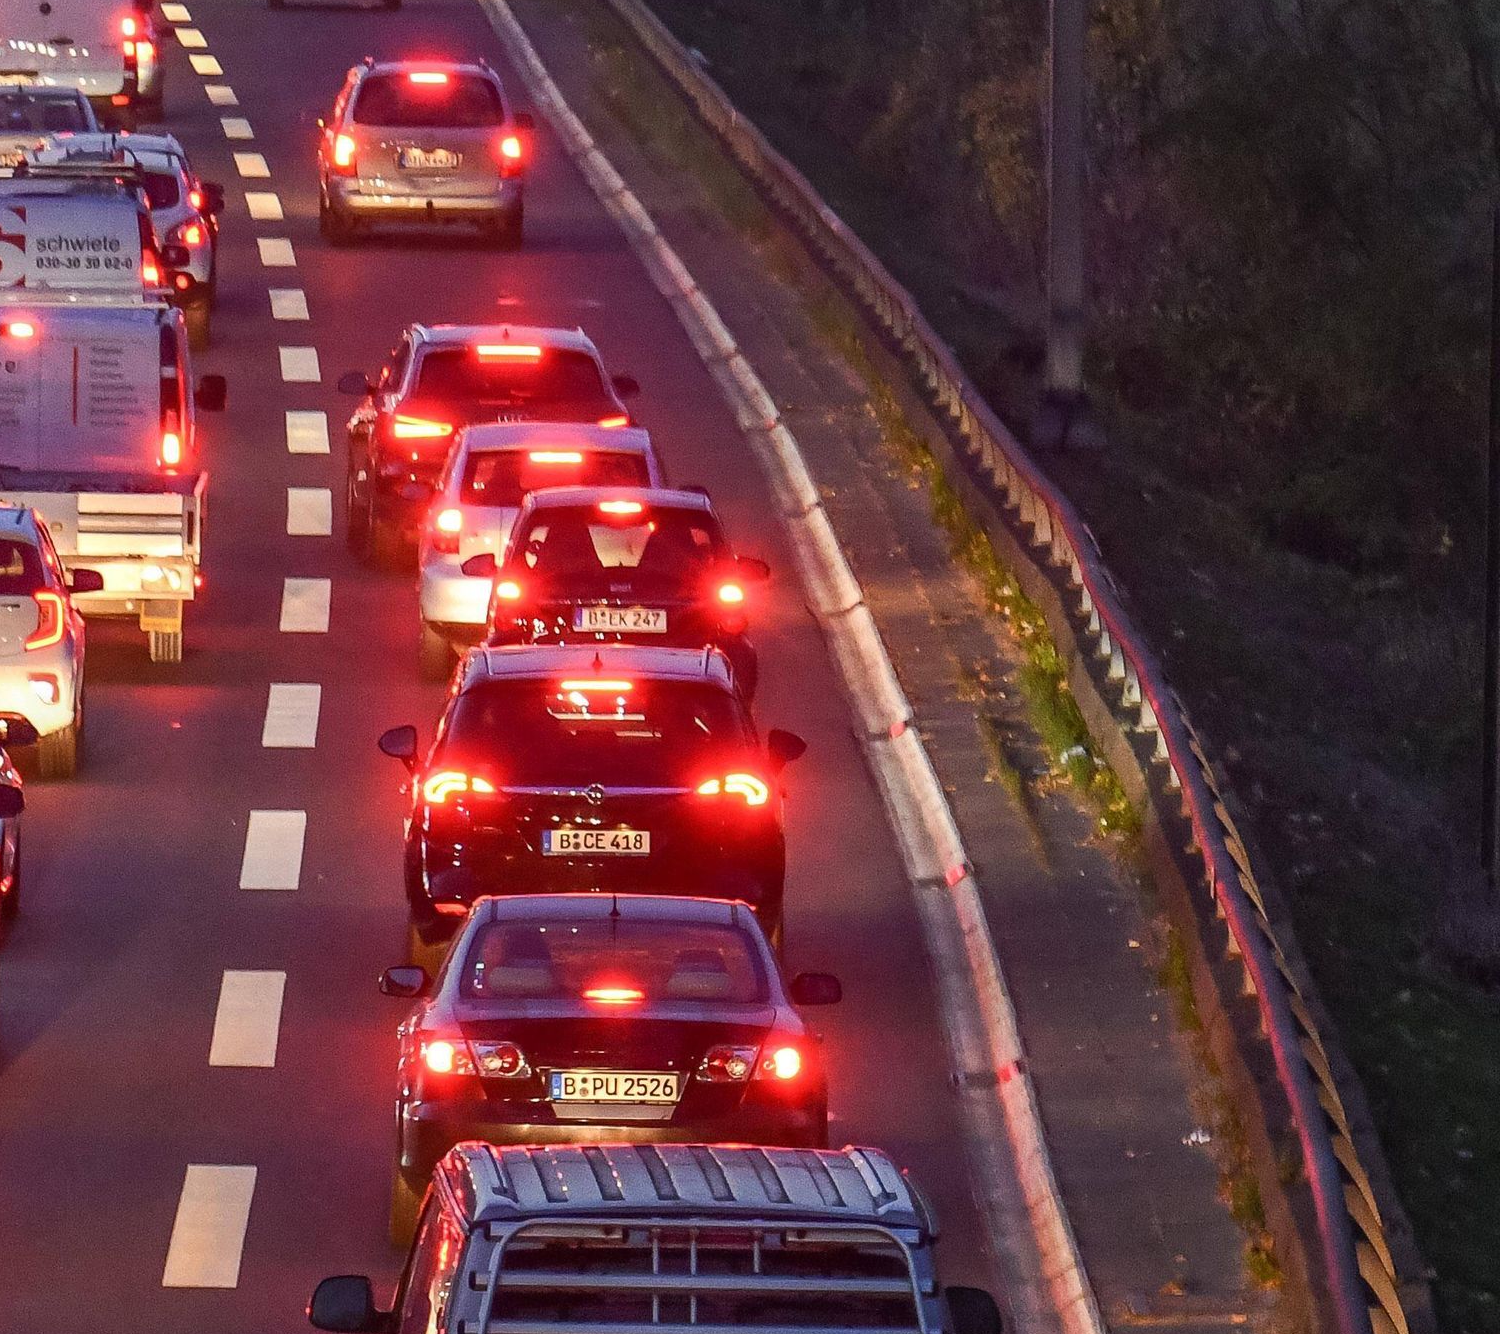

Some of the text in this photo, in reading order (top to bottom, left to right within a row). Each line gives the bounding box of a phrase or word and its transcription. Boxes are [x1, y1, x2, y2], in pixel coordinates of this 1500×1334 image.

[560, 834, 643, 850] B CE 418
[564, 1077, 674, 1097] B PU 2526
